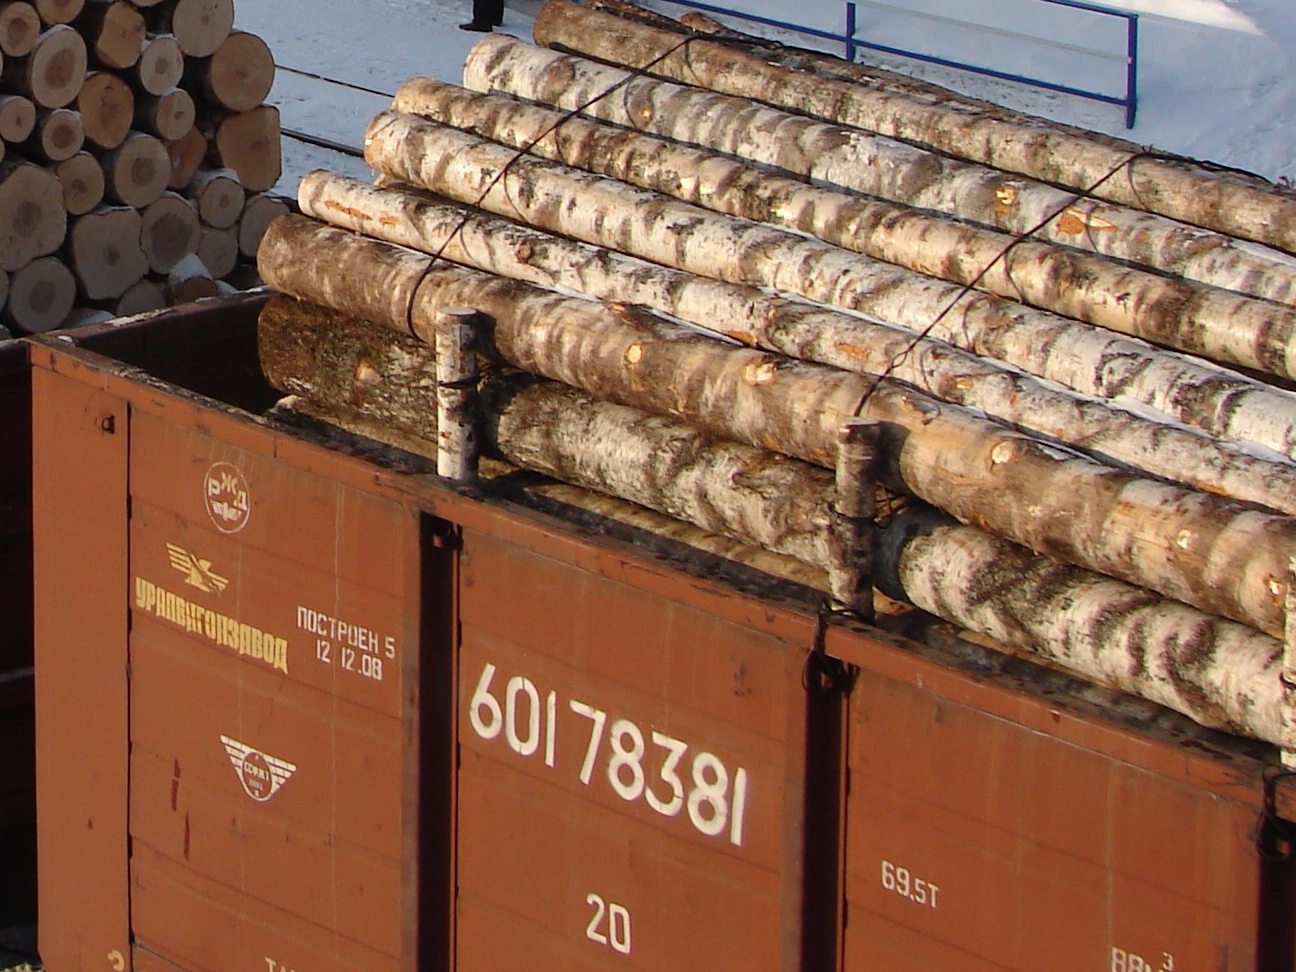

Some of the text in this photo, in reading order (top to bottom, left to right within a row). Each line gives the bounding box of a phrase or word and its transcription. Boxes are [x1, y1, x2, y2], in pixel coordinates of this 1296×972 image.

[208, 471, 248, 511] РЖД
[296, 605, 396, 660] ПОСТРОЕН 5
[315, 639, 332, 664] 12
[468, 661, 749, 848] 60178381
[585, 893, 632, 955] 20
